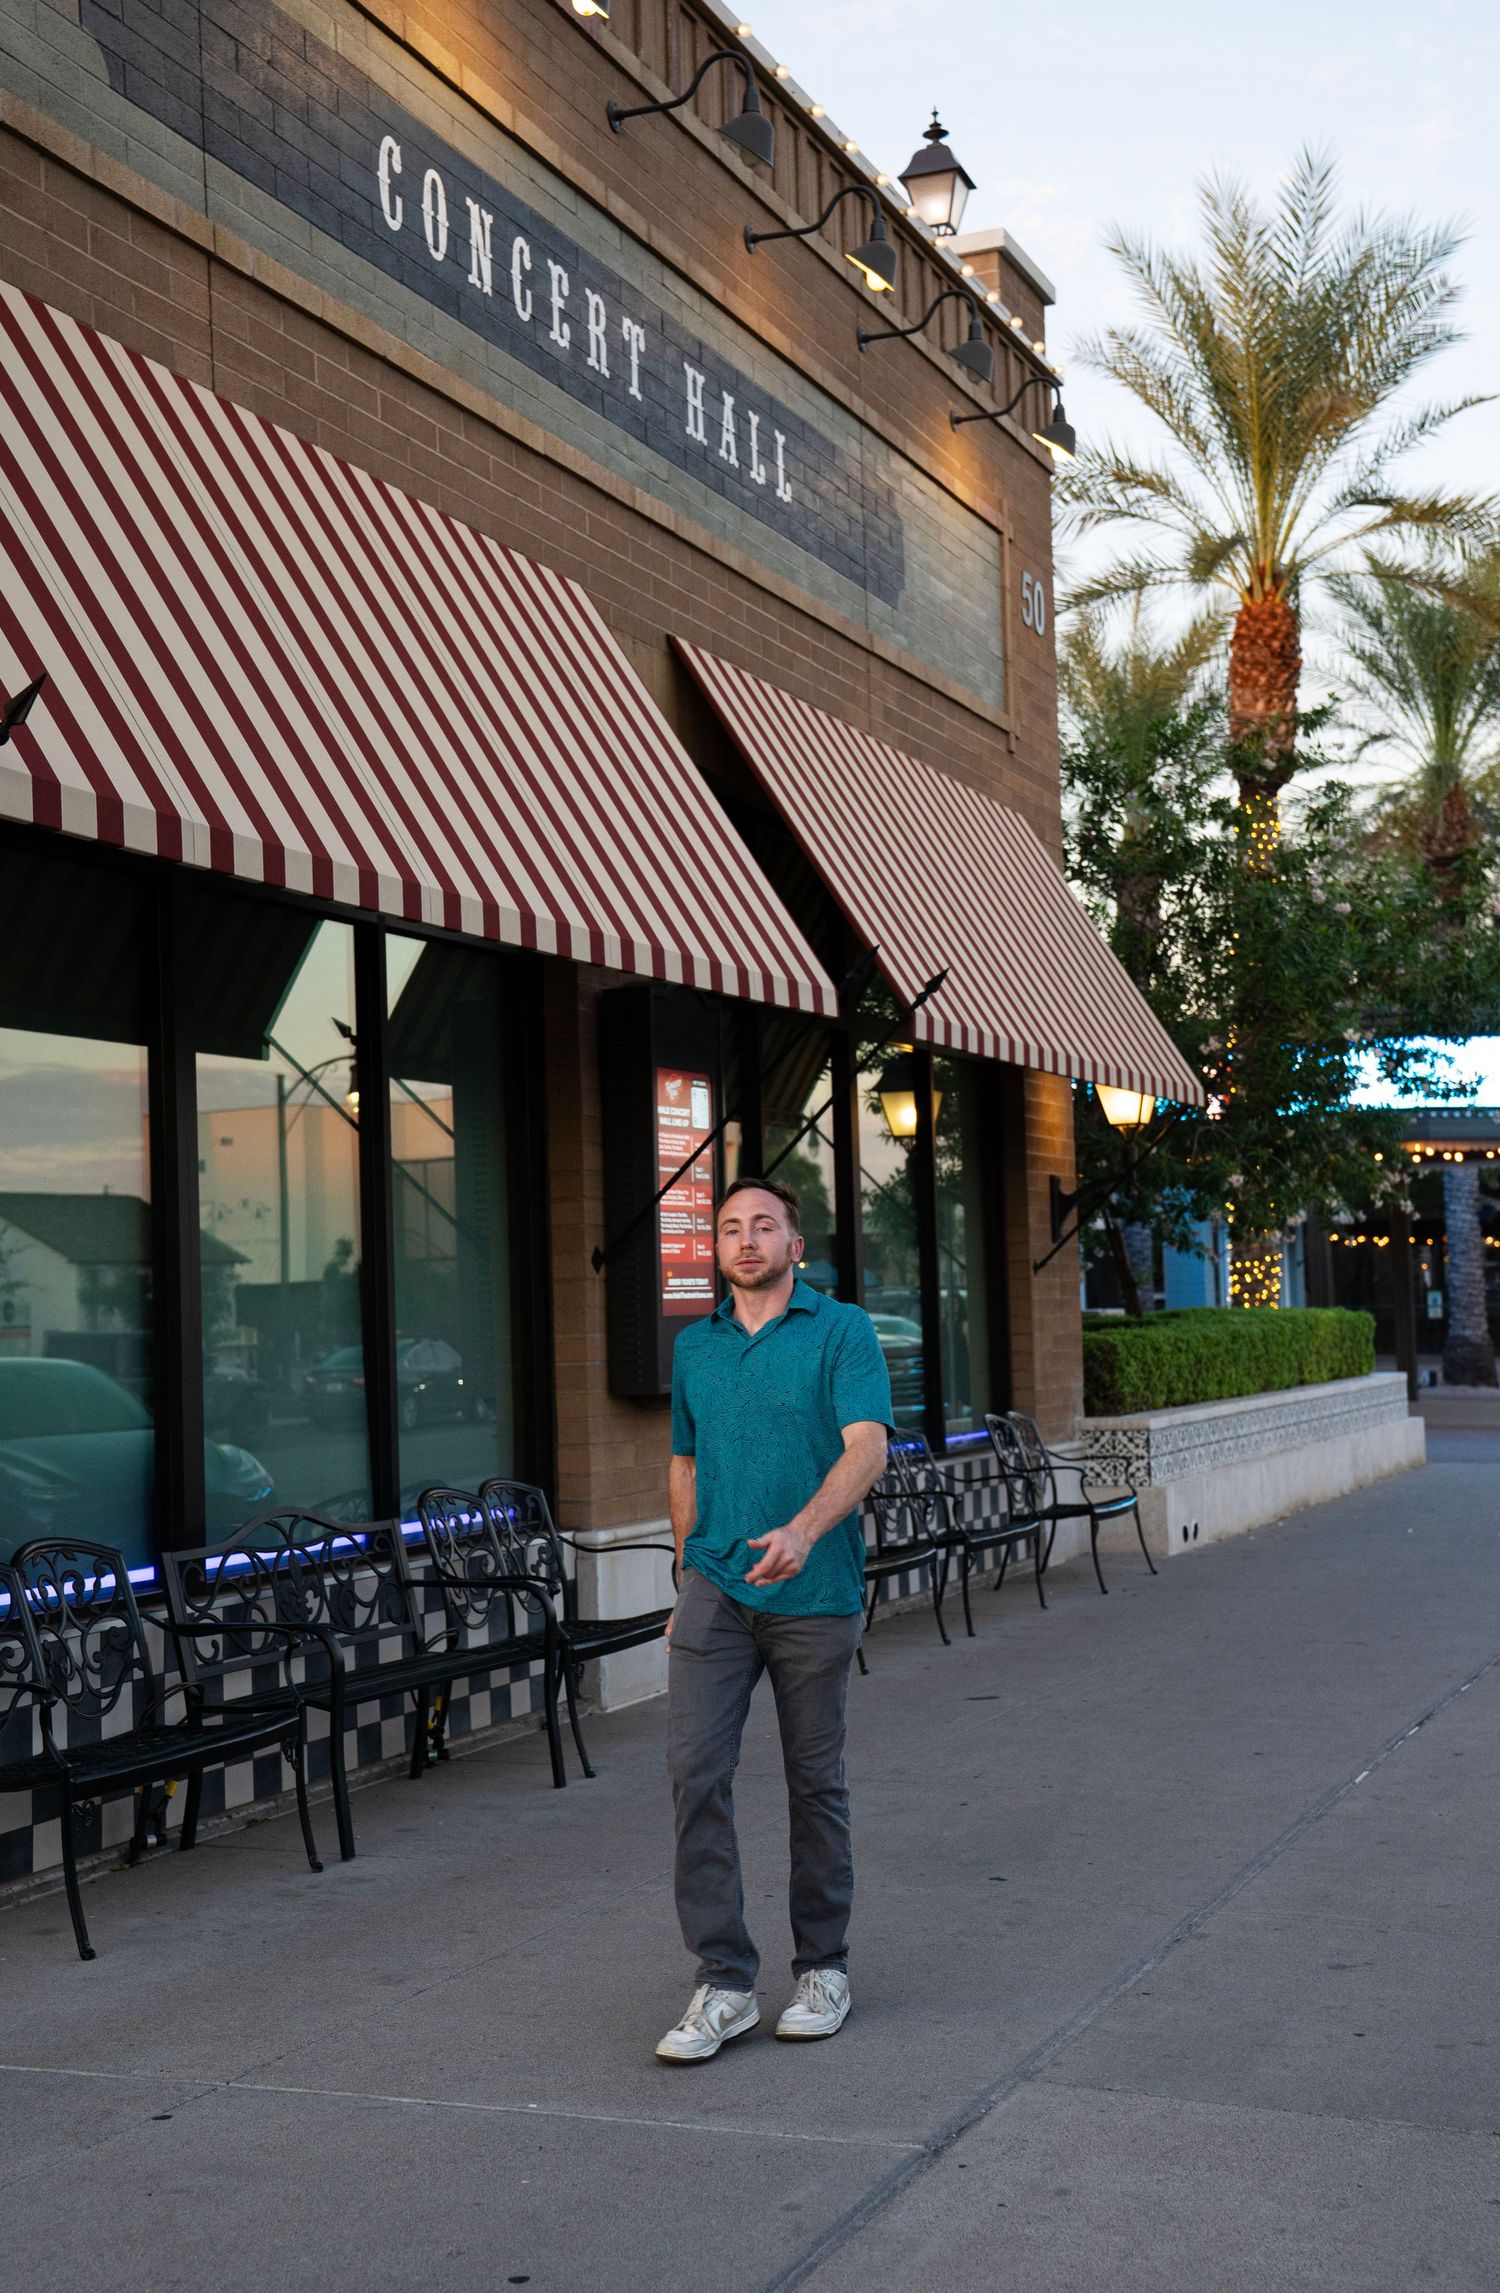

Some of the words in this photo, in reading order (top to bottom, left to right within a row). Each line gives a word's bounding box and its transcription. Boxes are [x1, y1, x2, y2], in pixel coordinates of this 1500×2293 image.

[377, 135, 646, 402] CONCERT
[683, 362, 792, 503] HALL
[1021, 570, 1045, 637] 50
